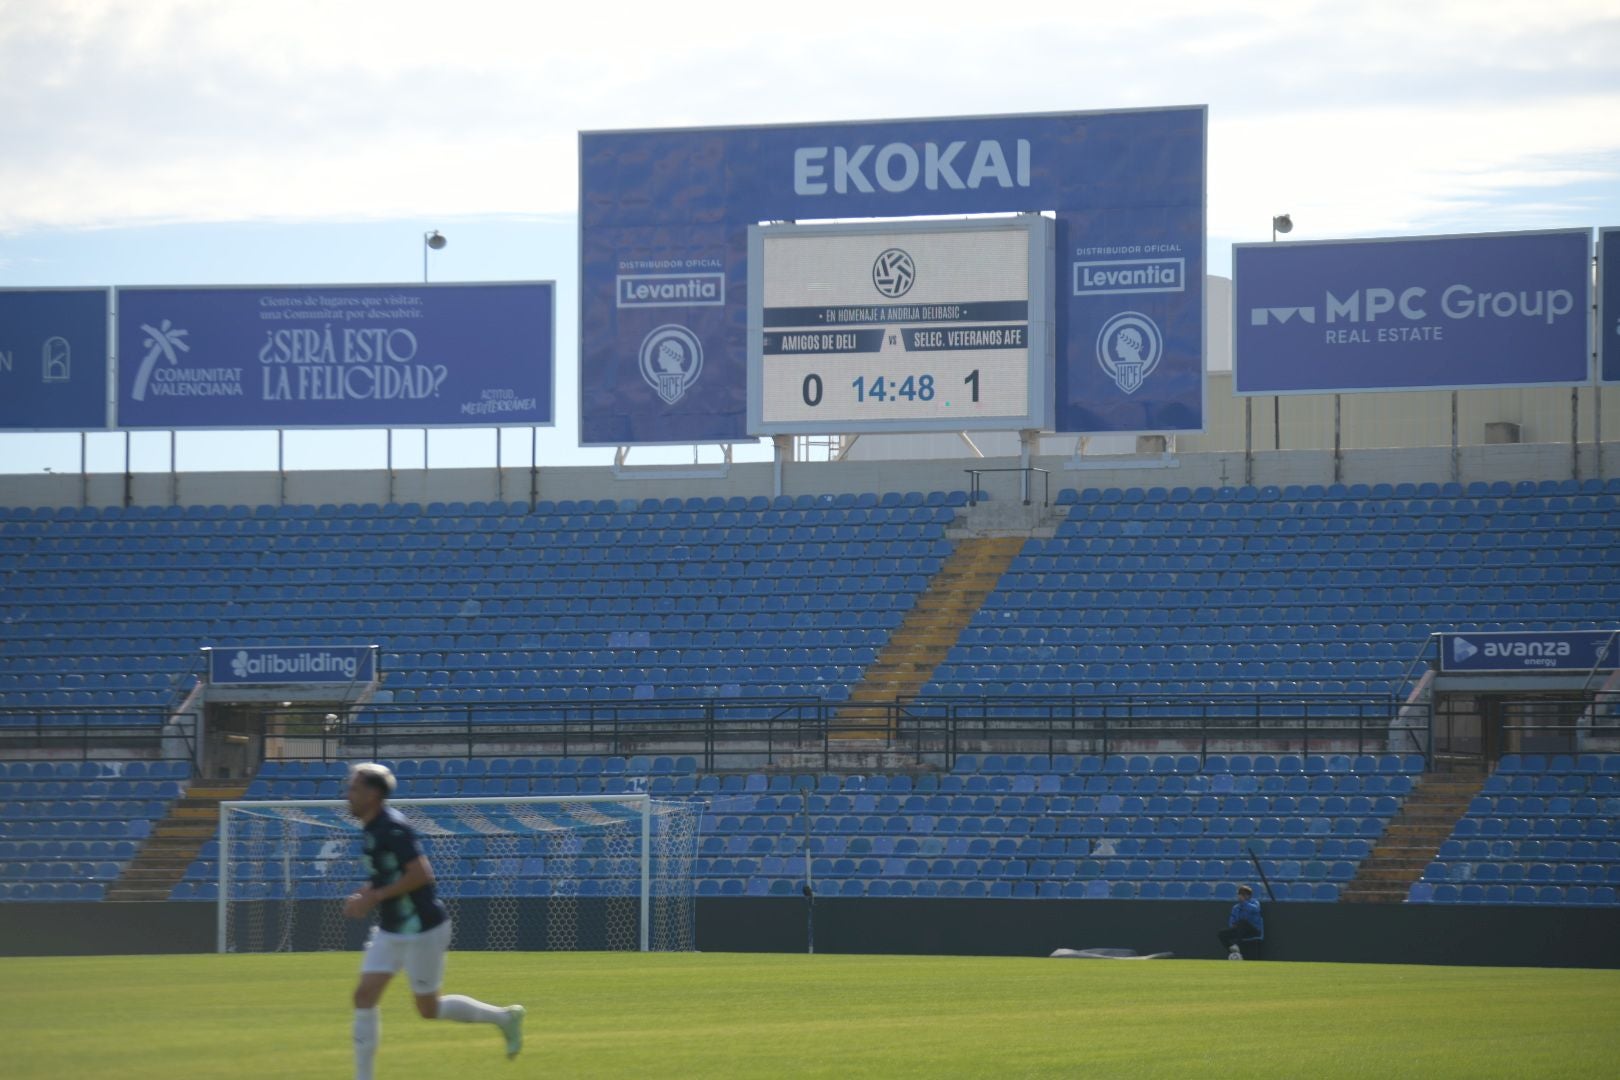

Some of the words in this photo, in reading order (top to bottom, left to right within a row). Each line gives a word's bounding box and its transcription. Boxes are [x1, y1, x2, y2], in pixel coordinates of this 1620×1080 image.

[794, 139, 1031, 195] EKOKAI
[1076, 246, 1142, 256] DISTRIBUIDOR
[1144, 243, 1182, 253] OFICIAL
[619, 260, 683, 269] DISTRIBUIDOR
[685, 258, 722, 268] OFICIAL
[1083, 265, 1175, 286] Levantia
[626, 279, 717, 299] Levantia
[258, 296, 303, 307] Cientos
[304, 296, 318, 306] de
[320, 295, 360, 308] lugares
[362, 296, 382, 308] que
[1326, 286, 1427, 323] MPC
[1441, 284, 1573, 324] Group
[259, 311, 281, 320] una
[283, 309, 344, 319] Comunitat
[346, 310, 366, 321] por
[826, 309, 837, 322] EN
[838, 308, 878, 321] HOMENAJE
[880, 308, 886, 320] A
[887, 307, 920, 320] ANDRIJA
[922, 306, 960, 319] DELIBASIC
[258, 323, 337, 363] ¿SERÁ
[343, 328, 418, 362] ESTO
[782, 335, 820, 351] AMIGOS
[822, 335, 834, 350] DE
[836, 334, 856, 349] DELI
[914, 332, 945, 347] SELEC.
[947, 330, 1002, 346] VETERANOS
[1004, 329, 1022, 345] AFE
[1326, 329, 1370, 344] REAL
[1377, 326, 1443, 342] ESTATE
[154, 368, 243, 382] COMUNITAT
[262, 365, 293, 400] LA
[298, 363, 449, 400] FELICIDAD?
[152, 382, 244, 396] VALENCIANA
[802, 373, 823, 407] 0
[852, 374, 935, 402] 14:48
[964, 369, 979, 402] 1
[1484, 642, 1570, 657] avanza
[247, 652, 357, 678] alibuilding
[1524, 658, 1557, 667] energy
